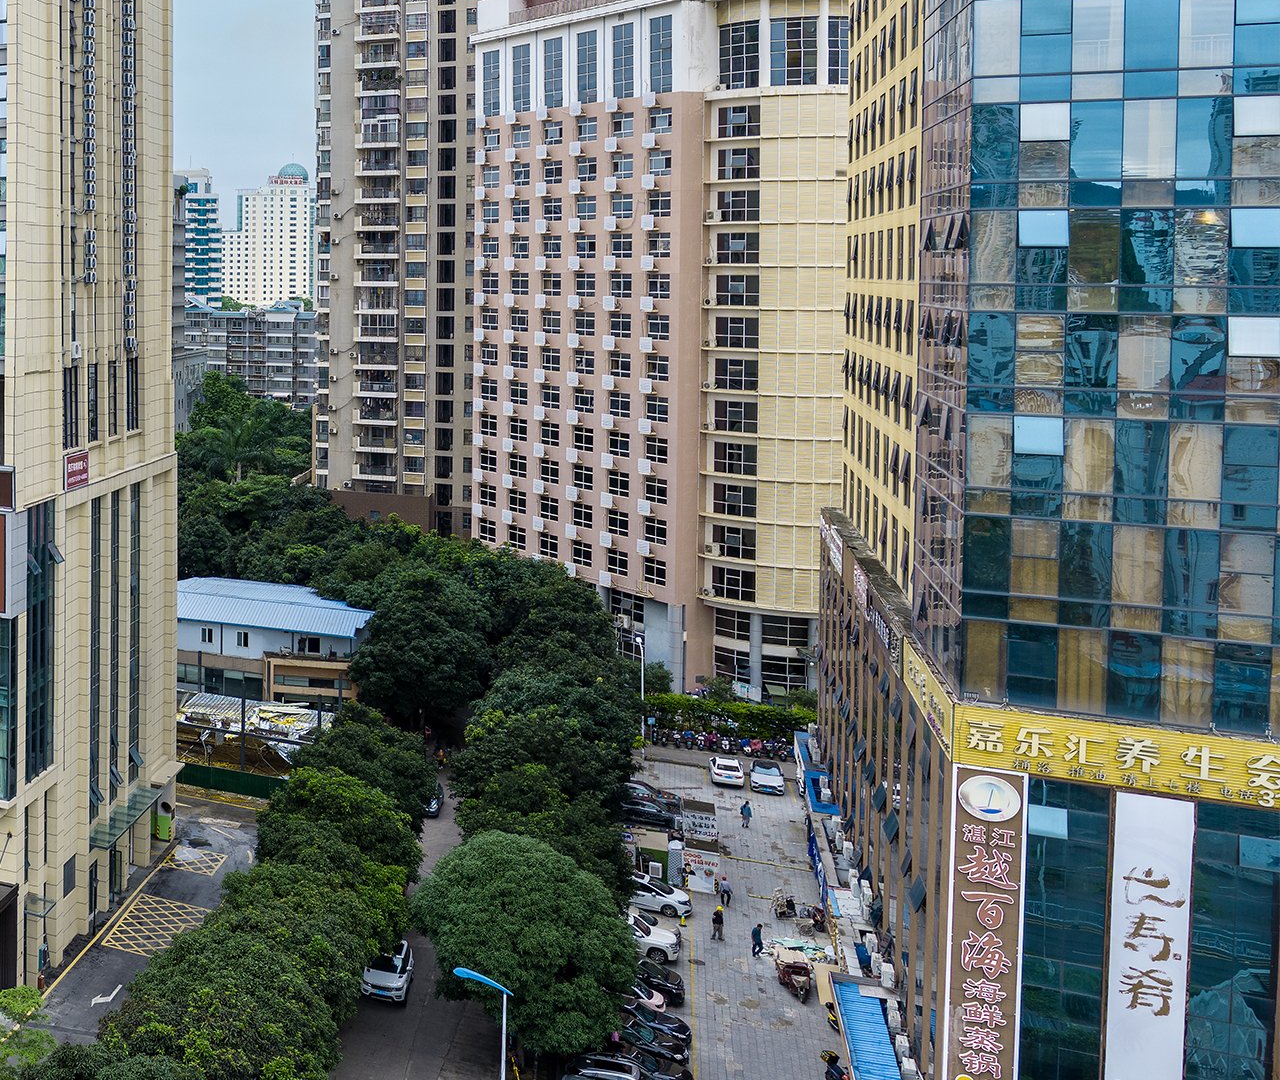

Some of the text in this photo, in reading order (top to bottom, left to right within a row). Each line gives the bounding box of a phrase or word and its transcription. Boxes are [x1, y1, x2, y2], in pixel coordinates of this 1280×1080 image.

[966, 719, 1280, 789] 嘉乐汇养生会
[1012, 759, 1053, 774] 桶浴
[1068, 765, 1107, 781] 推油
[1120, 772, 1202, 794] 请上七楼
[1220, 786, 1258, 800] 电话
[962, 824, 1016, 848] 湛江
[958, 845, 1018, 979] 越百海
[959, 979, 1007, 1079] 海鲜蒸锅
